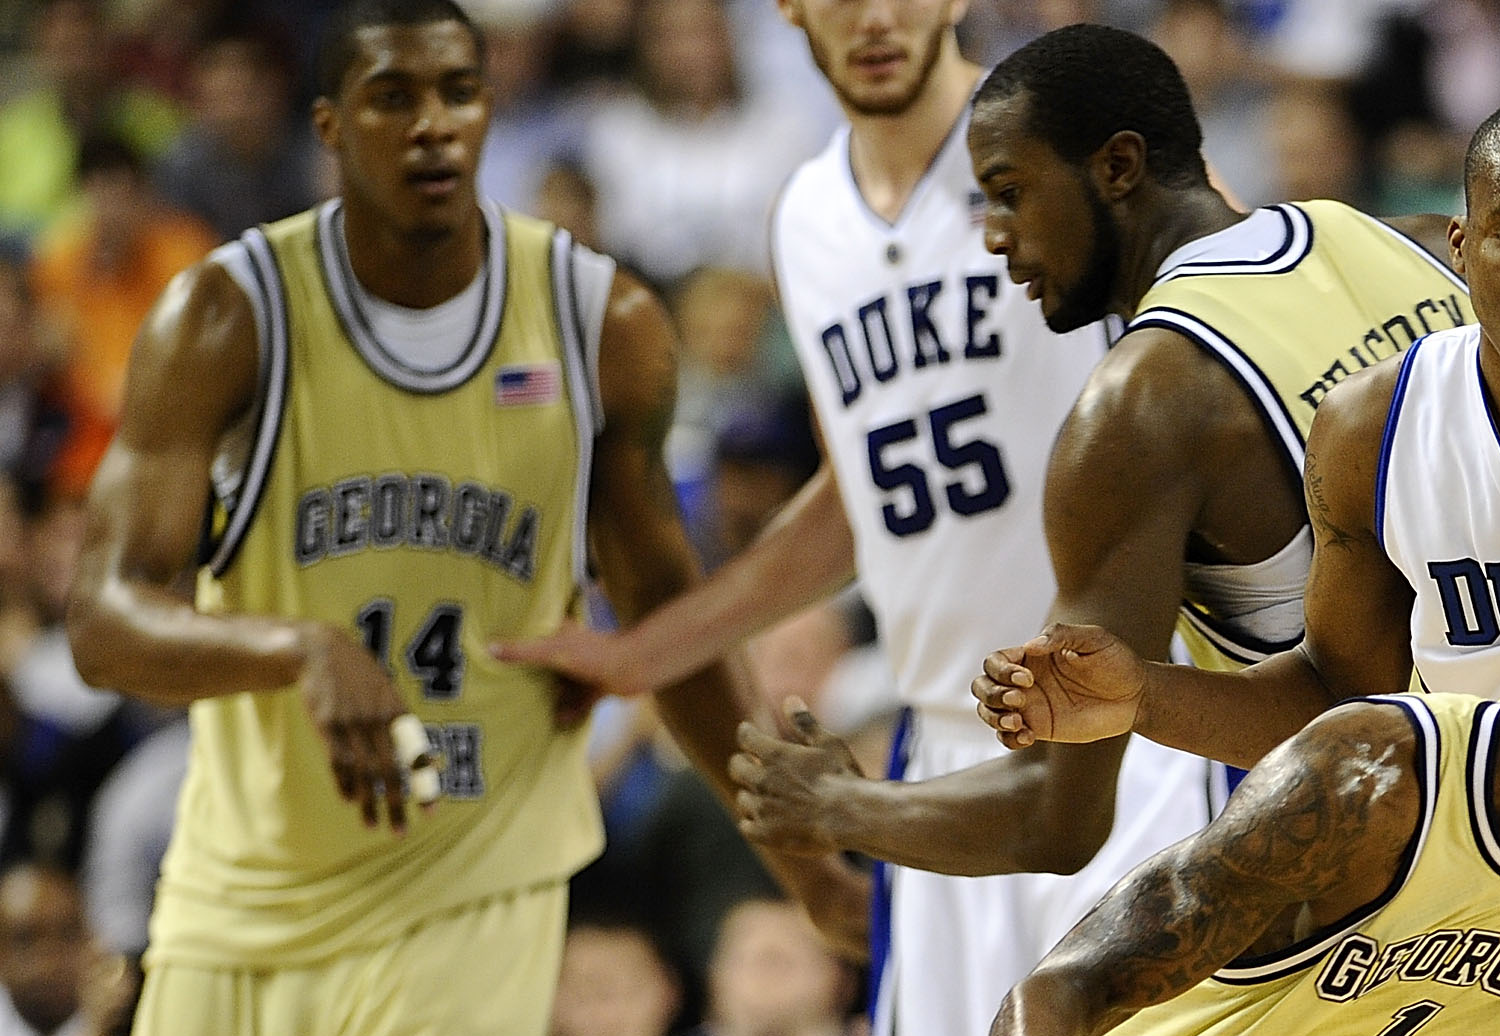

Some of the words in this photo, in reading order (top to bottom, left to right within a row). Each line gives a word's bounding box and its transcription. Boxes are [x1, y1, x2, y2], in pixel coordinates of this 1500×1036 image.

[821, 274, 1001, 407] DUKE
[866, 394, 1010, 537] 55
[296, 472, 540, 584] GEORGIA
[357, 597, 464, 700] 14
